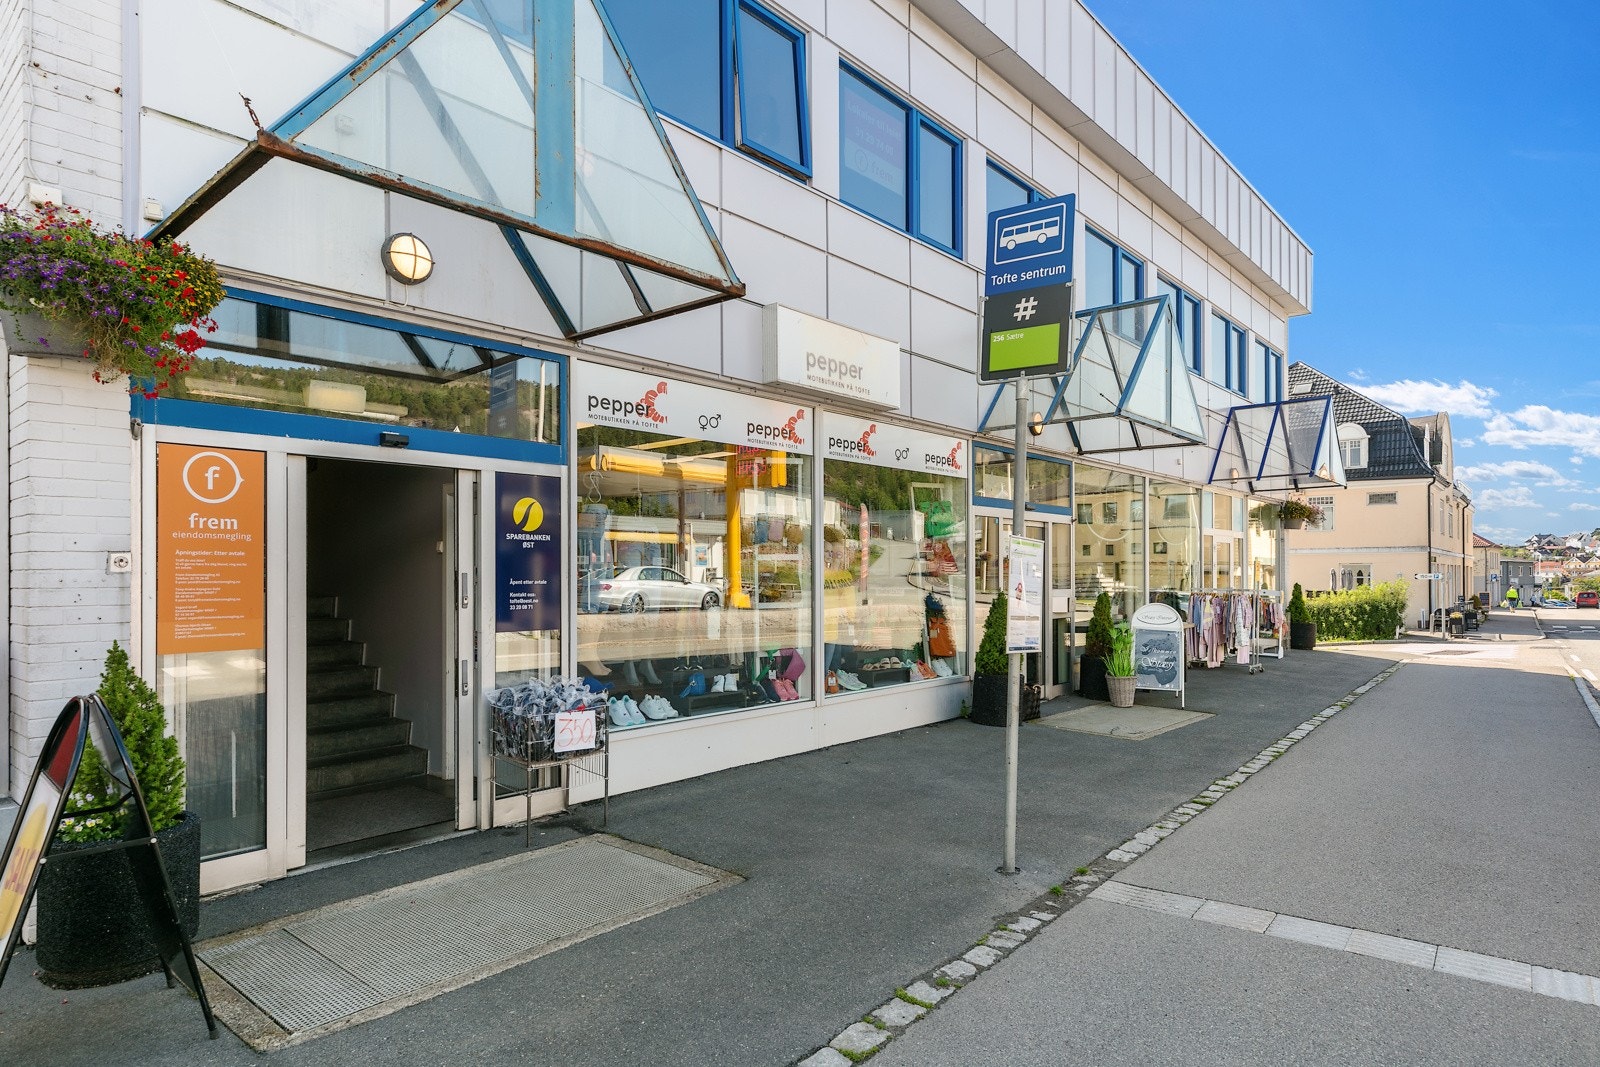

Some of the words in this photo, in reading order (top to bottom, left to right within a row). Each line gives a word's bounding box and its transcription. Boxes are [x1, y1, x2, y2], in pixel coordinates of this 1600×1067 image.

[991, 274, 1018, 286] Tofte
[1020, 264, 1066, 281] sentrum
[993, 334, 1004, 343] 256
[1006, 332, 1025, 341] Sætre
[806, 351, 863, 380] pepper
[588, 394, 651, 417] pepper
[588, 413, 630, 424] MOTEBUTIKKEN
[641, 421, 659, 429] TOFTE
[747, 420, 793, 440] pepper
[828, 436, 867, 453] pepper
[925, 453, 955, 467] pepper
[205, 466, 220, 490] f
[189, 512, 238, 530] frem
[172, 531, 252, 541] eiendomsmegling
[506, 533, 551, 541] SPAREBANKEN
[509, 578, 523, 586] Åpent
